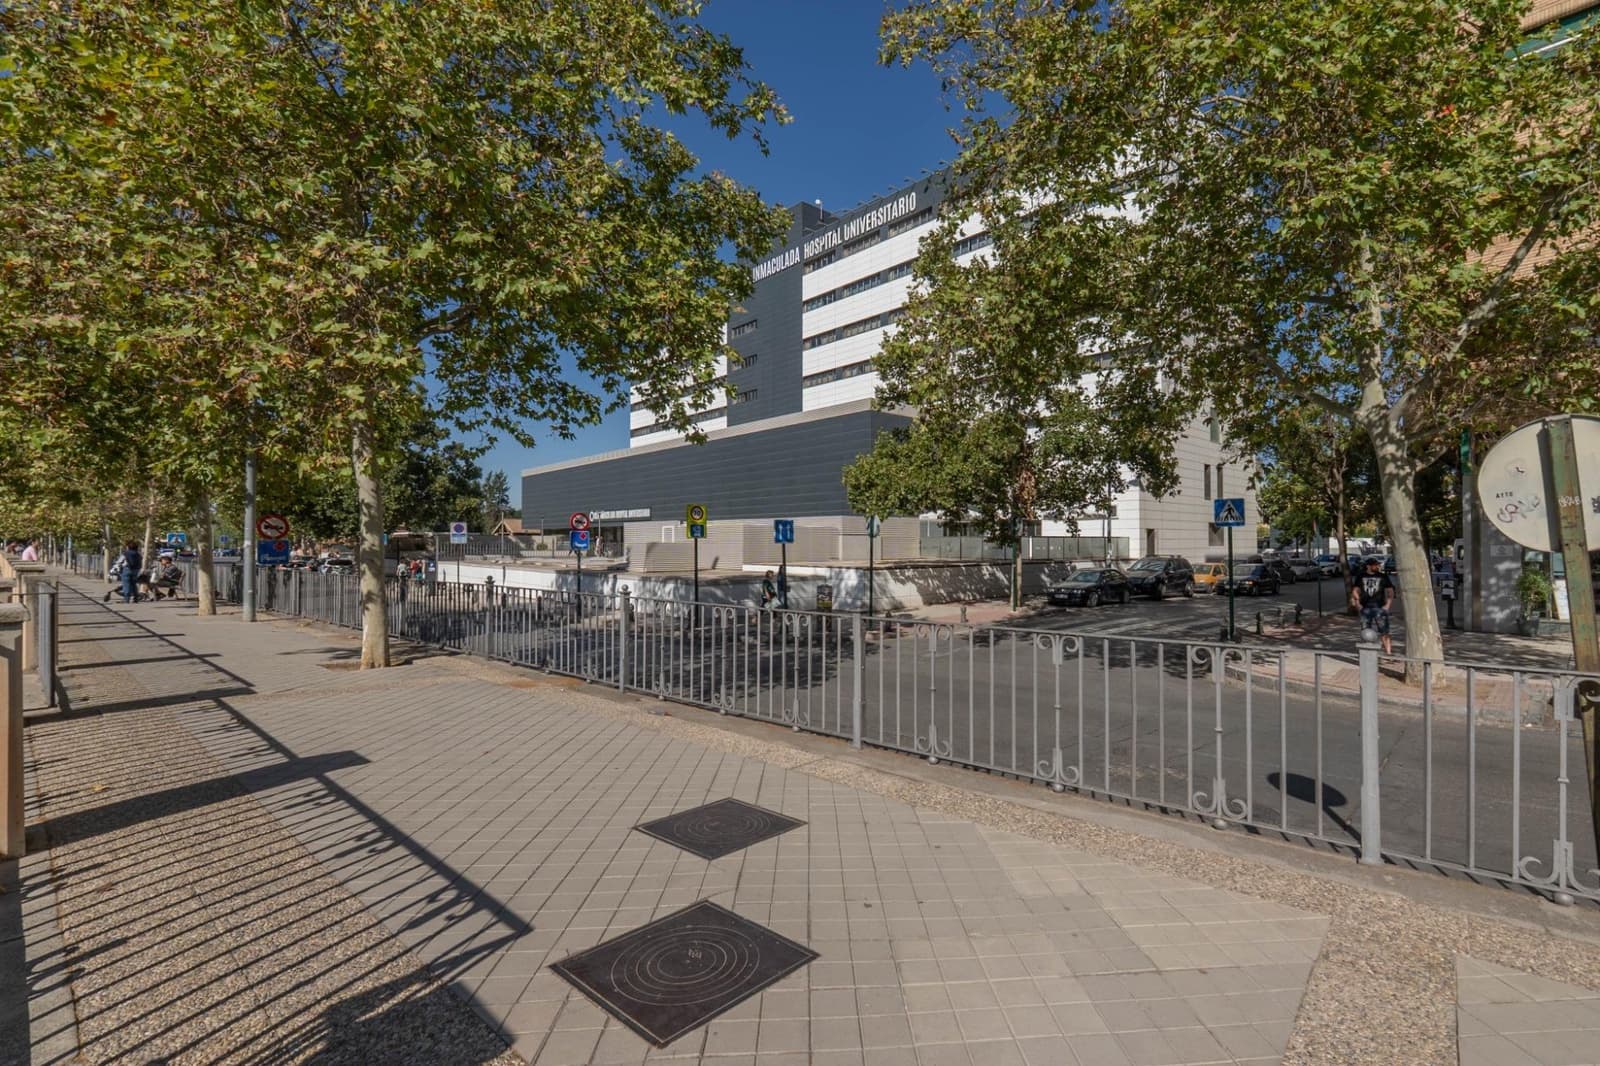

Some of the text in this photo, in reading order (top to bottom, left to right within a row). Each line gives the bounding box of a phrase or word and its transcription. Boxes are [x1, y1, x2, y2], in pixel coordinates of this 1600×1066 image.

[752, 191, 917, 283] INMACULADA HOSPITAL UNIVERSITARIO
